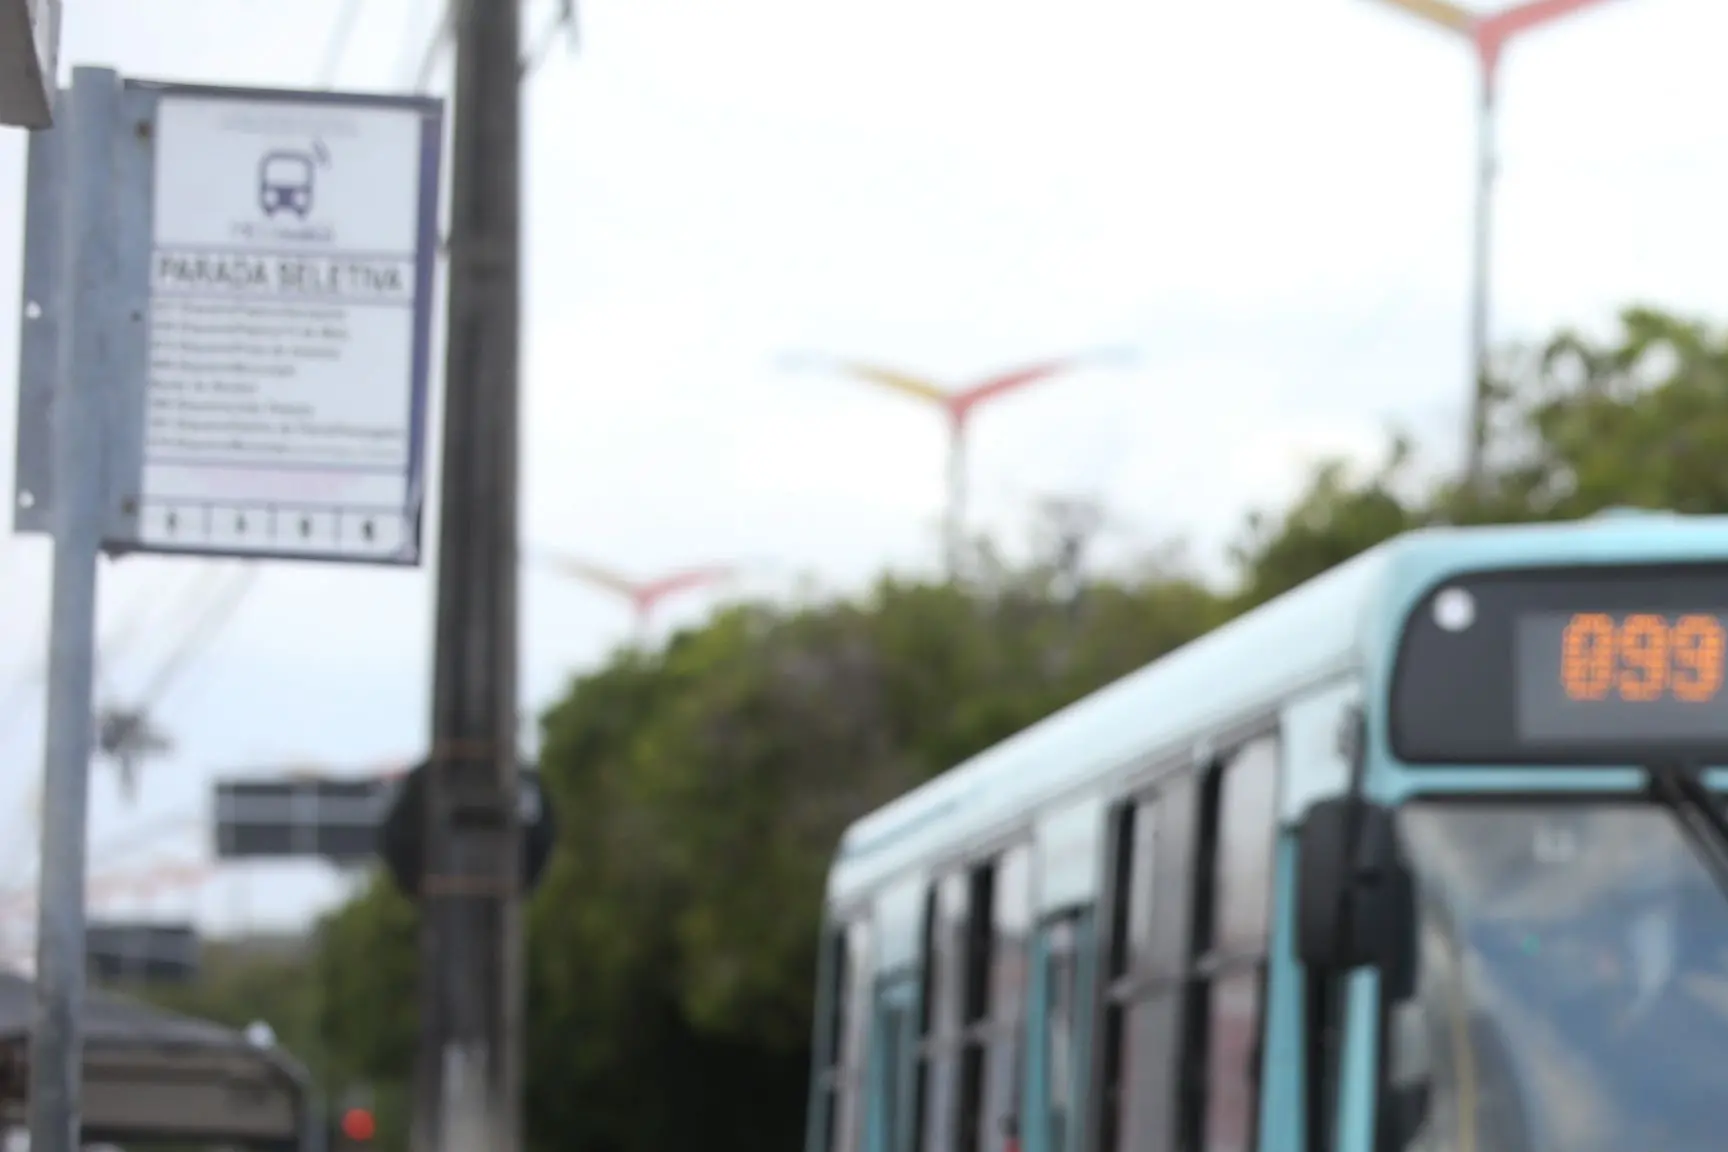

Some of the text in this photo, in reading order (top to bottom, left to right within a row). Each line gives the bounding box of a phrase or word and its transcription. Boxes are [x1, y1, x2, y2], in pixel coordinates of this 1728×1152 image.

[157, 256, 403, 292] PARADA SELETIVA
[1561, 613, 1725, 702] 099
